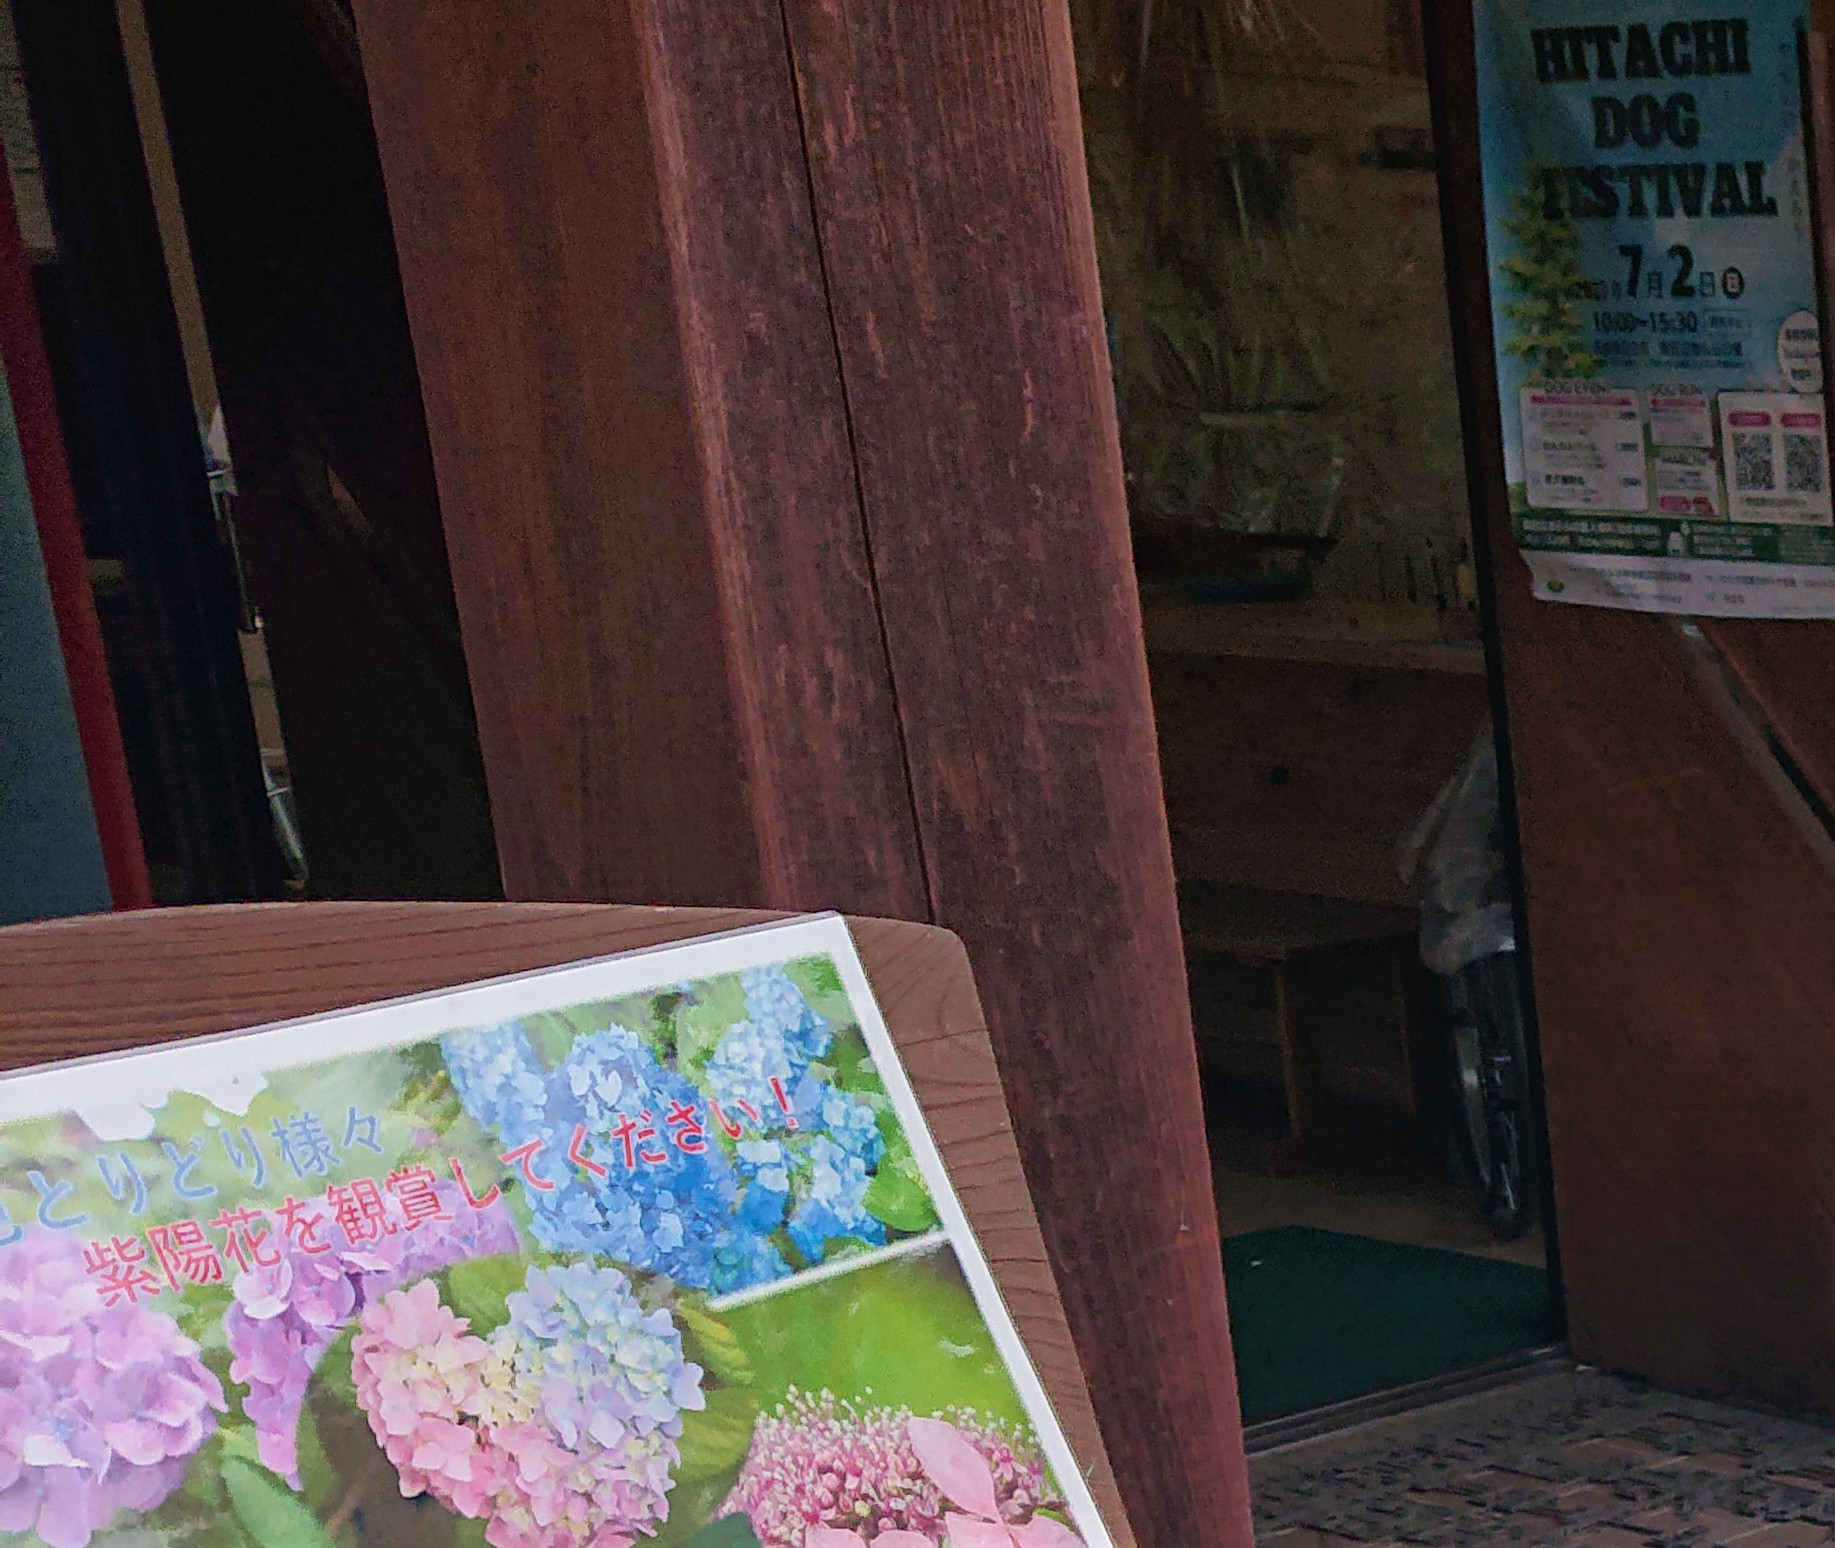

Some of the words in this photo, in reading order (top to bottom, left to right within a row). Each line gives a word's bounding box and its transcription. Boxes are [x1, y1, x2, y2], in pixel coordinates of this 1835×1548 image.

[1530, 18, 1751, 83] HITACHI
[1591, 92, 1701, 149] DOG
[1540, 160, 1778, 219] FESTIVAL
